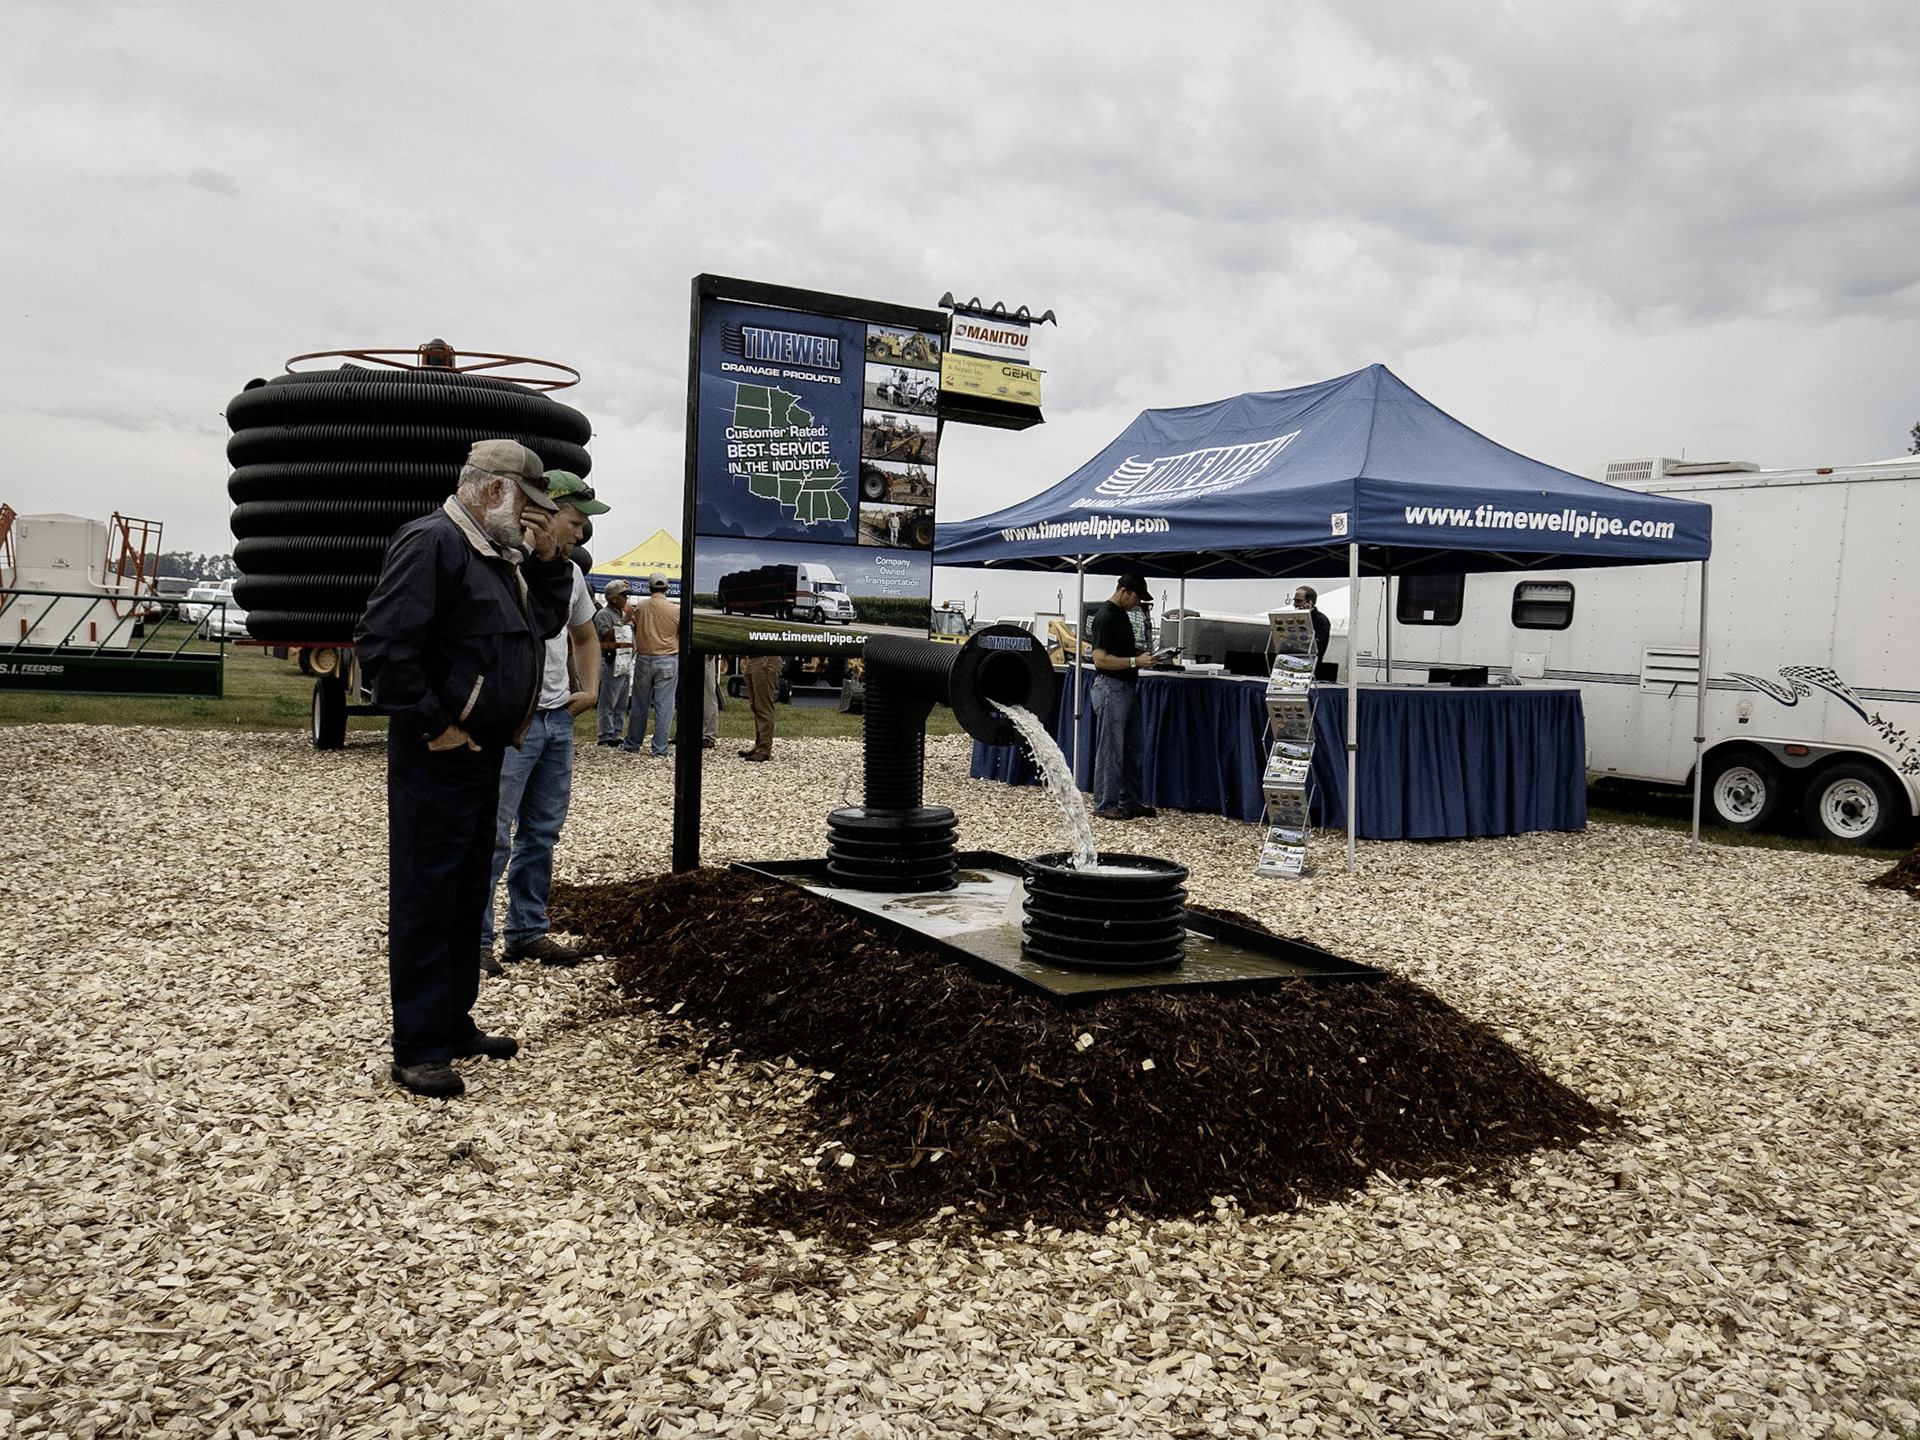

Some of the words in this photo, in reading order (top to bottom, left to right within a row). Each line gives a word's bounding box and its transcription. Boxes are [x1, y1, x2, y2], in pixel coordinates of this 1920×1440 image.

[967, 325, 1029, 347] MANITOU
[742, 326, 840, 369] TIMEWELL
[721, 362, 780, 376] DRAINAGE
[782, 370, 841, 384] PRODUCTS
[1002, 366, 1038, 382] GEHL
[725, 426, 786, 440] Customer
[789, 424, 829, 438] Rated:
[727, 443, 764, 459] BEST
[769, 441, 830, 456] SERVICE
[728, 462, 744, 473] IN
[745, 461, 769, 473] THE
[772, 458, 832, 472] INDUSTRY
[1117, 430, 1301, 497] TIMEWELL
[1001, 515, 1170, 542] www.timewellpipe.com
[1405, 503, 1675, 539] www.timewellpipe.com
[630, 561, 682, 569] SUZU
[875, 556, 911, 568] Company
[880, 567, 905, 576] Owned
[864, 576, 920, 587] Transportation
[882, 587, 902, 595] Fleet
[749, 631, 868, 646] www.timewellpipe.co
[987, 635, 1032, 651] TIMEWELL
[21, 664, 64, 673] FEEDERS
